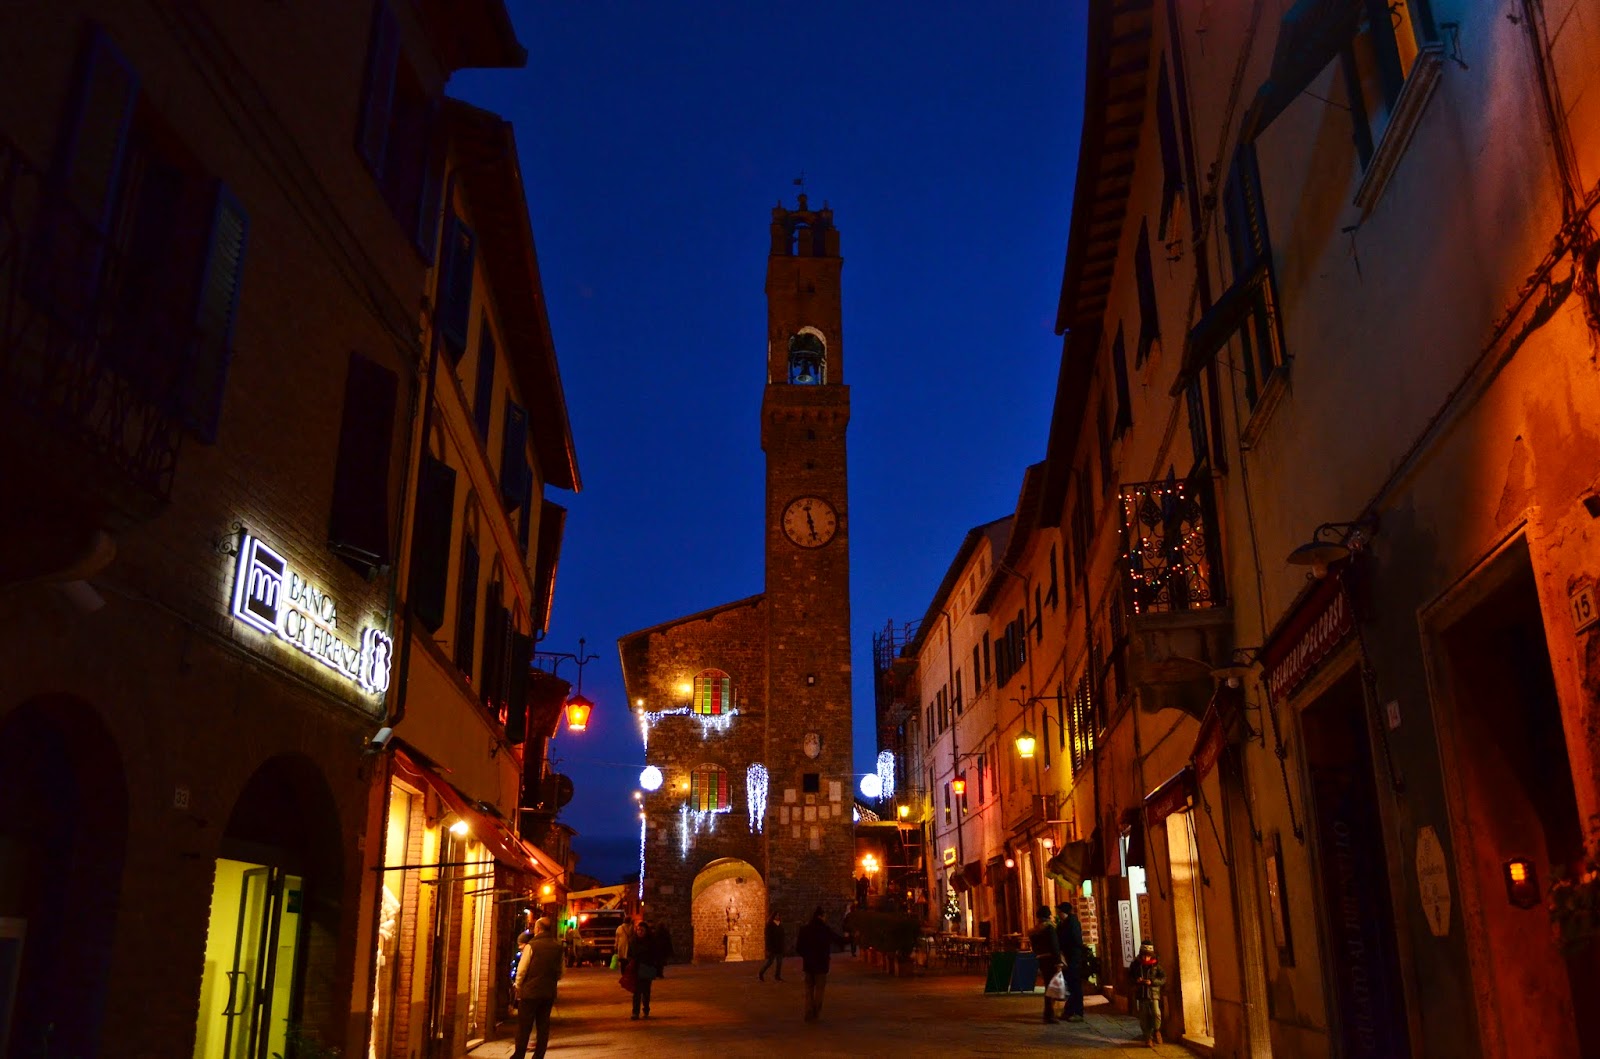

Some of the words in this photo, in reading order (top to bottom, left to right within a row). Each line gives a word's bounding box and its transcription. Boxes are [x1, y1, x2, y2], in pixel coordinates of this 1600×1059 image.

[288, 572, 338, 629] BANCA
[1574, 593, 1590, 622] 15
[285, 609, 307, 647] CR
[1122, 906, 1133, 959] PIZZERIA
